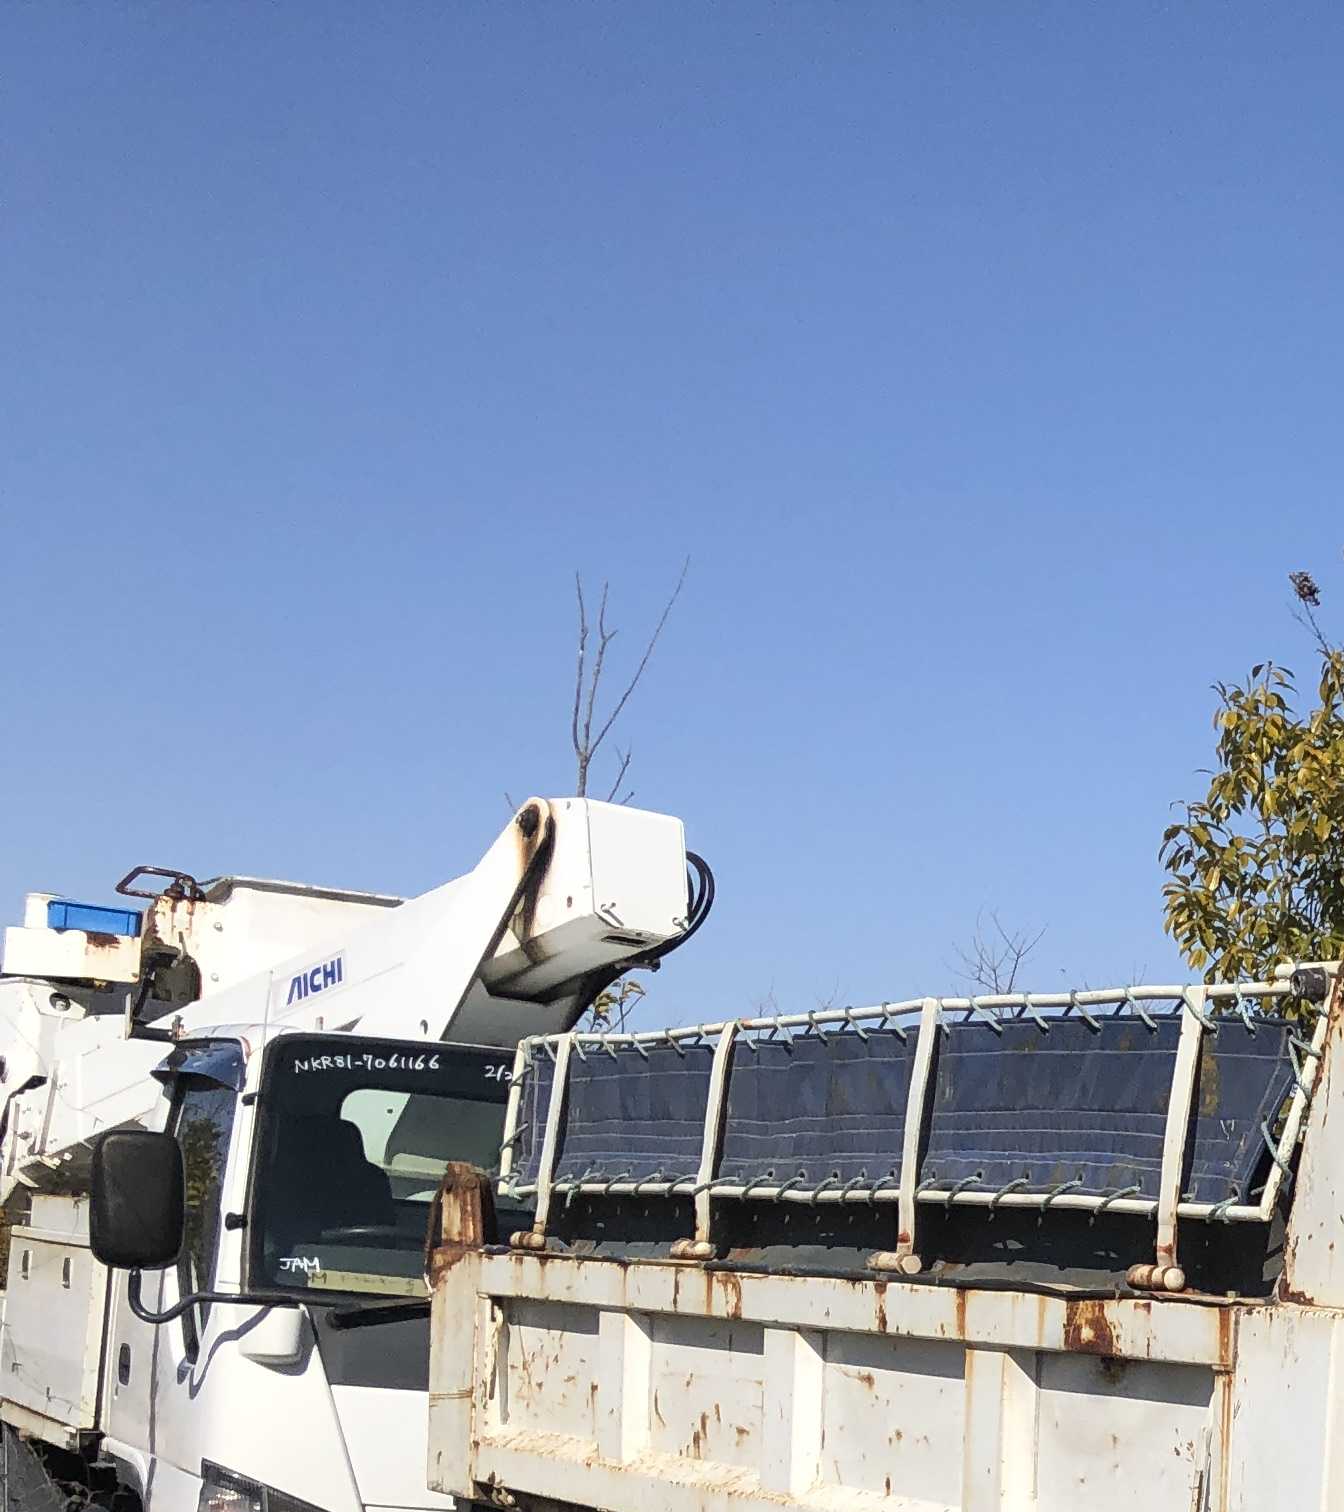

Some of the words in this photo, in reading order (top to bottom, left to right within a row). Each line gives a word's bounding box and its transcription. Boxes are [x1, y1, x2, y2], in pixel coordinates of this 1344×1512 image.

[287, 957, 343, 1006] AICHI
[294, 1054, 440, 1074] NKR81-7061166
[279, 1256, 320, 1273] JAM
